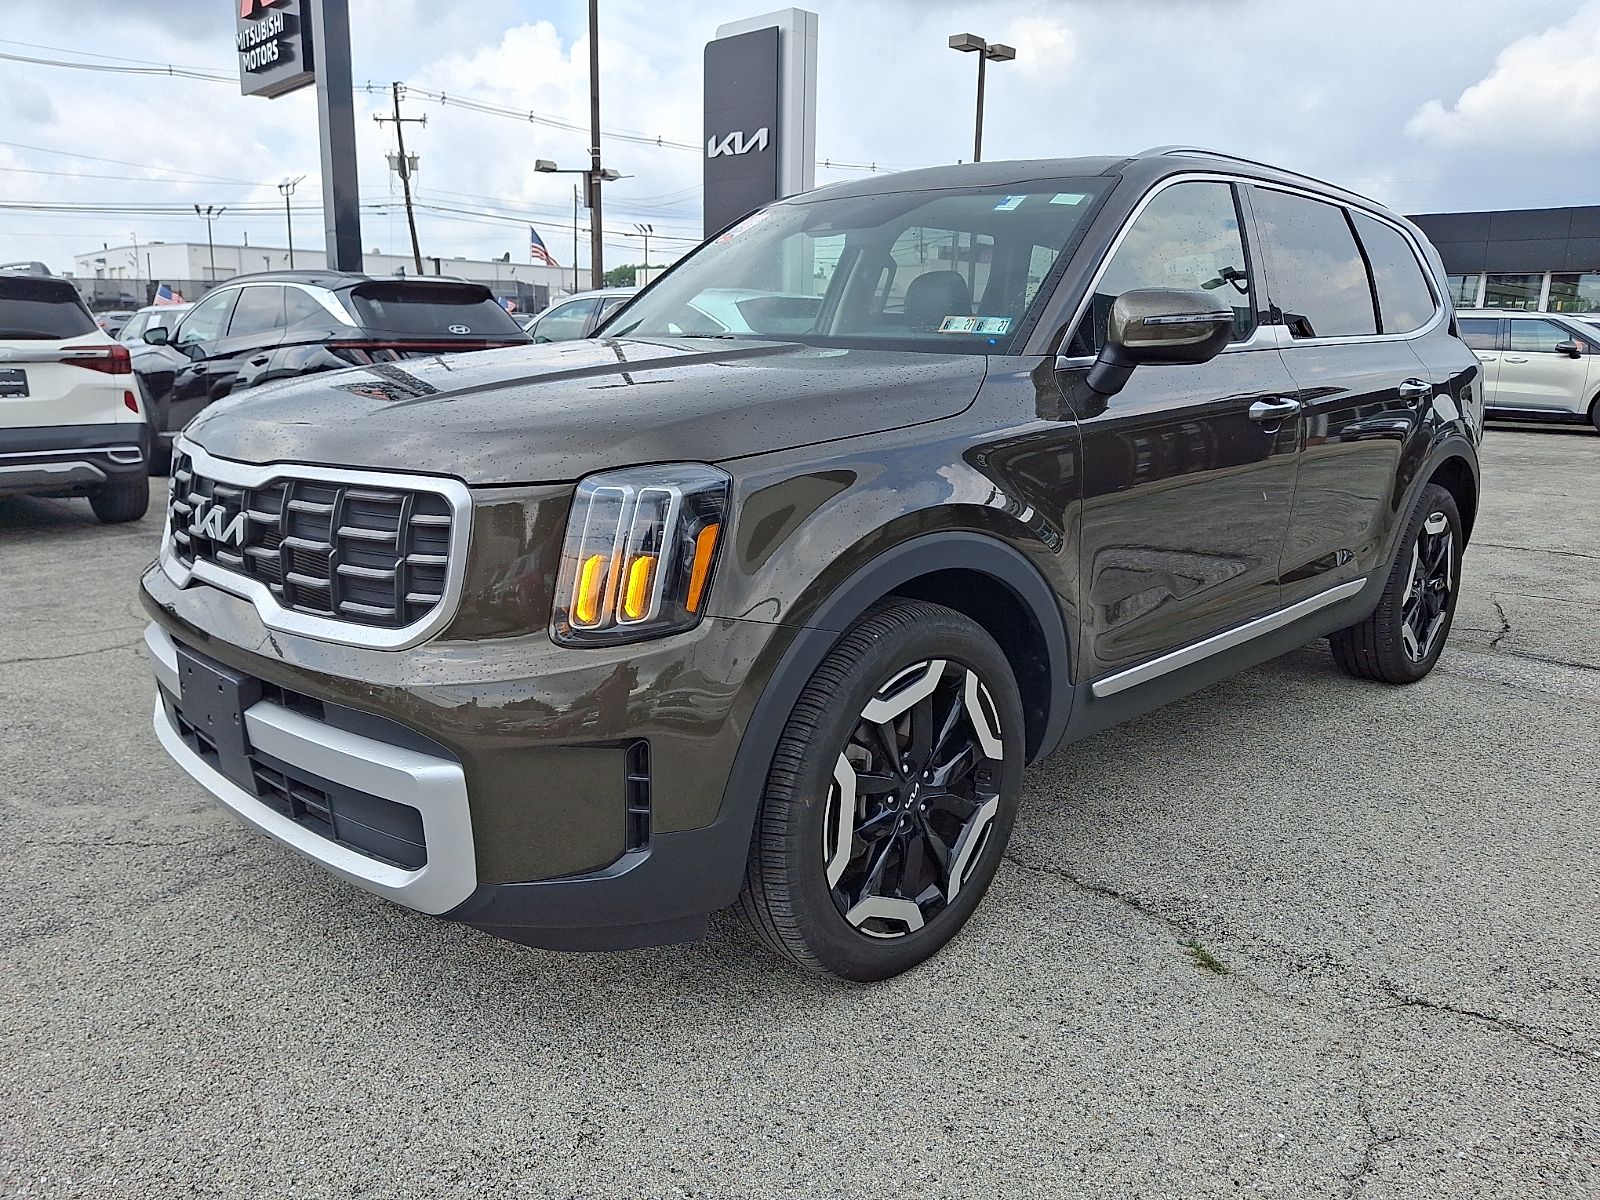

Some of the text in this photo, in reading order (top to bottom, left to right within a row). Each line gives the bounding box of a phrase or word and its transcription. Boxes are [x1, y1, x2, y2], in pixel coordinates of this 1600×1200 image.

[236, 12, 284, 50] MITSUBISHI
[243, 39, 279, 72] MOTORS
[707, 127, 769, 158] KIA
[997, 320, 1008, 332] 27
[193, 503, 247, 546] KIA
